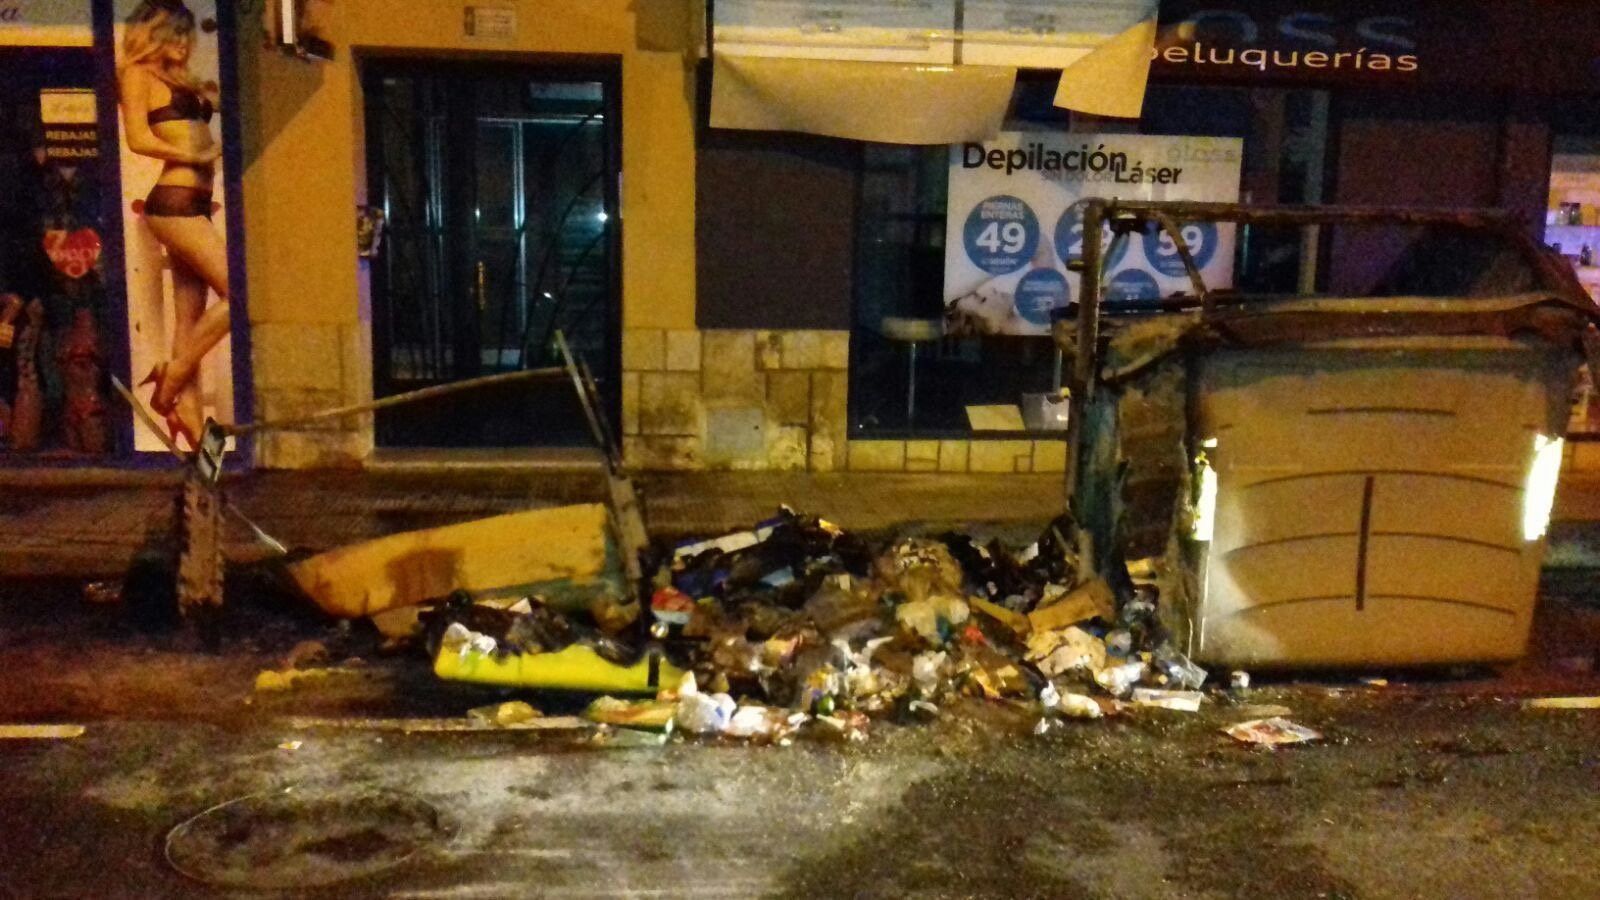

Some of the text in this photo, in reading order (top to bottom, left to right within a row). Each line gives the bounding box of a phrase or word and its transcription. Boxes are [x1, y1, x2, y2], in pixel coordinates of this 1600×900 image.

[46, 130, 97, 140] REBAJAS
[47, 147, 99, 157] REBAJAS
[962, 143, 1127, 175] Depilación
[1114, 160, 1182, 184] Láser
[975, 221, 1026, 254] 49
[1156, 224, 1204, 257] 59
